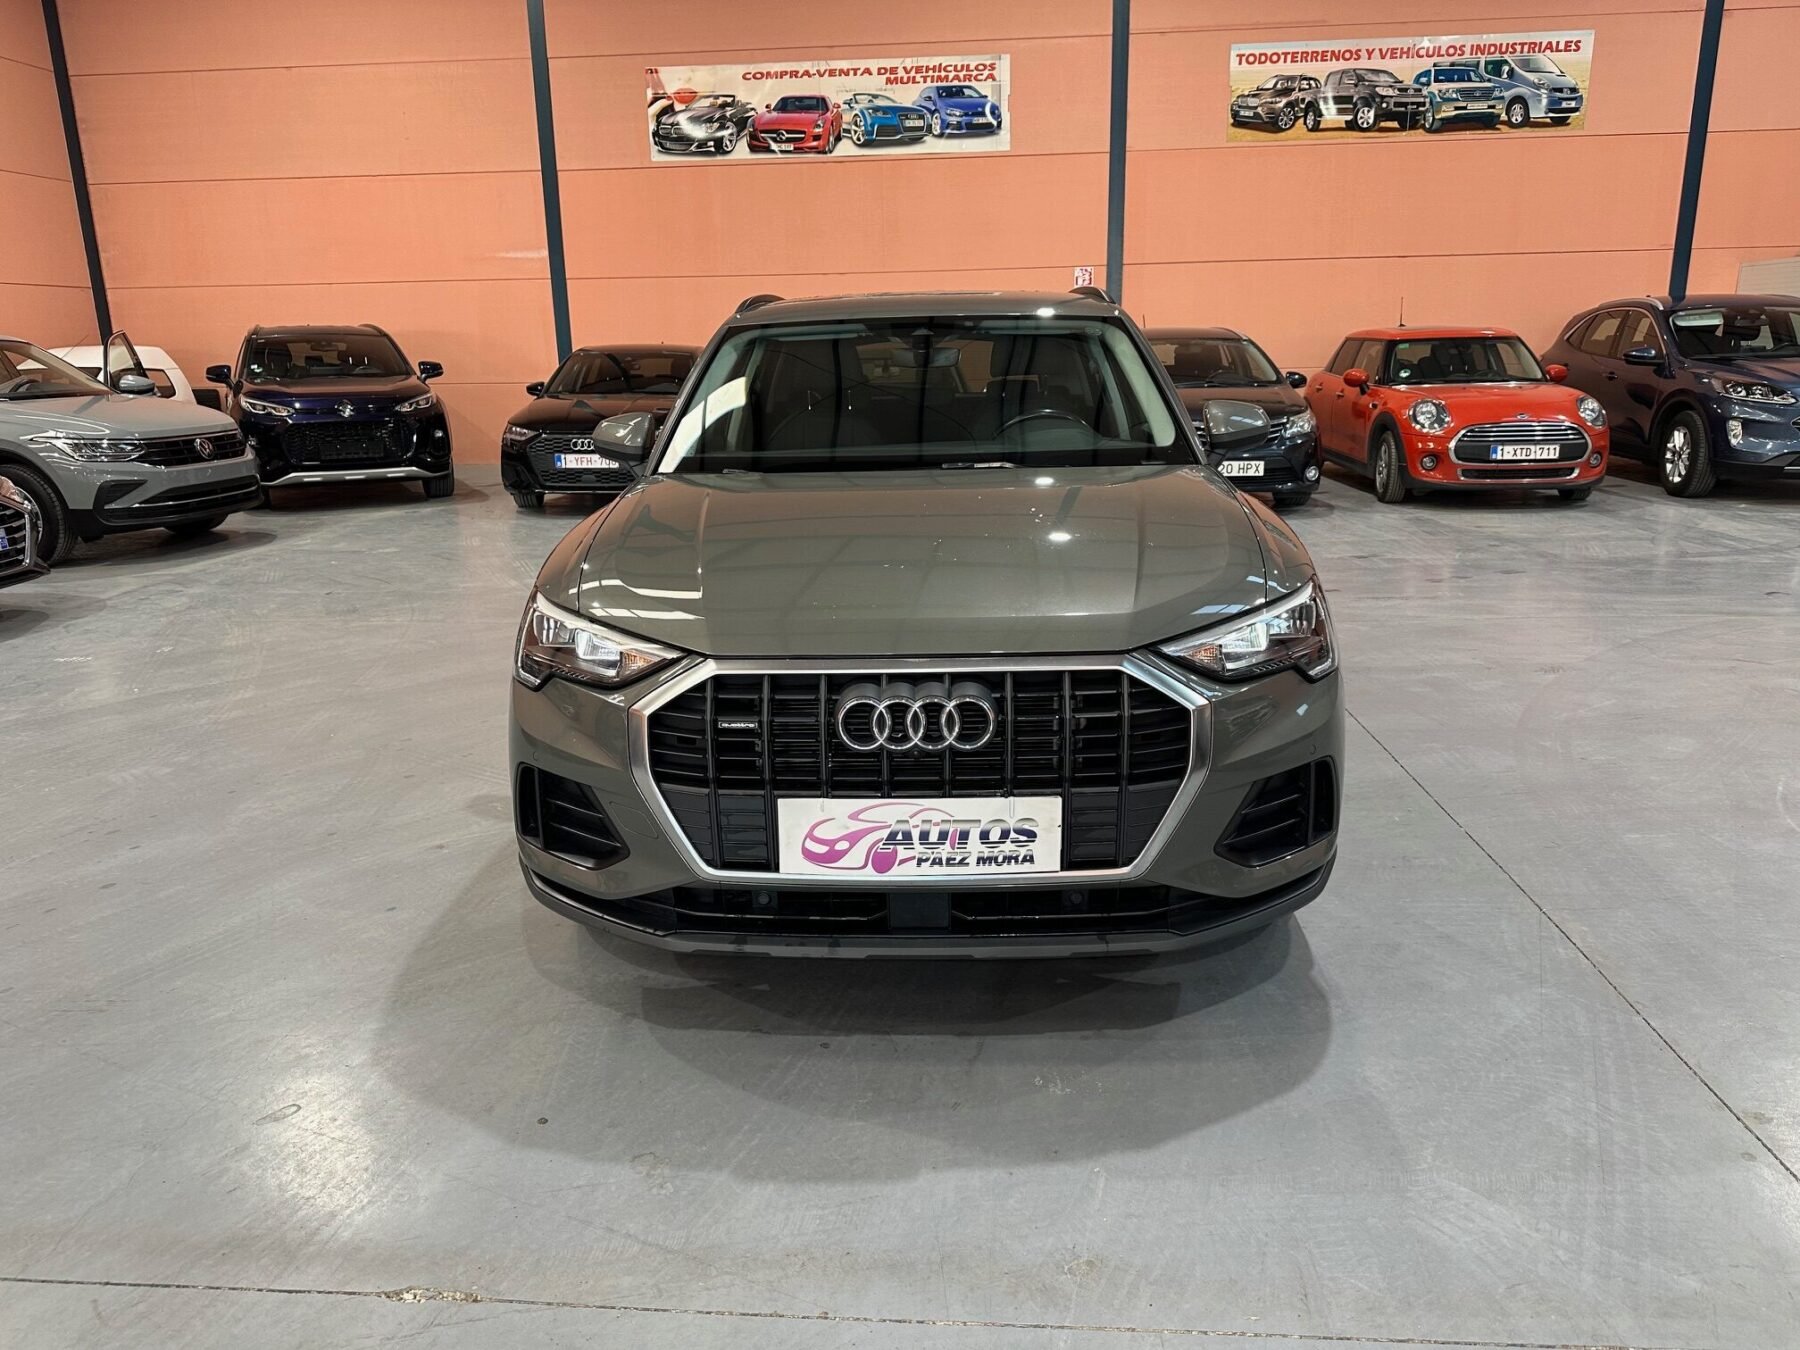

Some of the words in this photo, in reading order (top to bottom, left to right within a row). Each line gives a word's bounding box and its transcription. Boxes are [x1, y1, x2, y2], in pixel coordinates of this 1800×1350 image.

[1236, 48, 1362, 66] TODOTERRENOS
[1365, 47, 1377, 60] Y
[1379, 43, 1466, 60] VEHÍCULOS
[1469, 39, 1582, 57] INDUSTRIALES
[741, 67, 873, 81] COMPRA-VENTA
[876, 65, 900, 76] DE
[902, 62, 997, 75] VEHÍCULOS
[885, 72, 997, 86] MULTIMARCA
[1238, 463, 1261, 475] HPX
[880, 817, 1039, 850] AUTOS
[976, 850, 1035, 867] MORA
